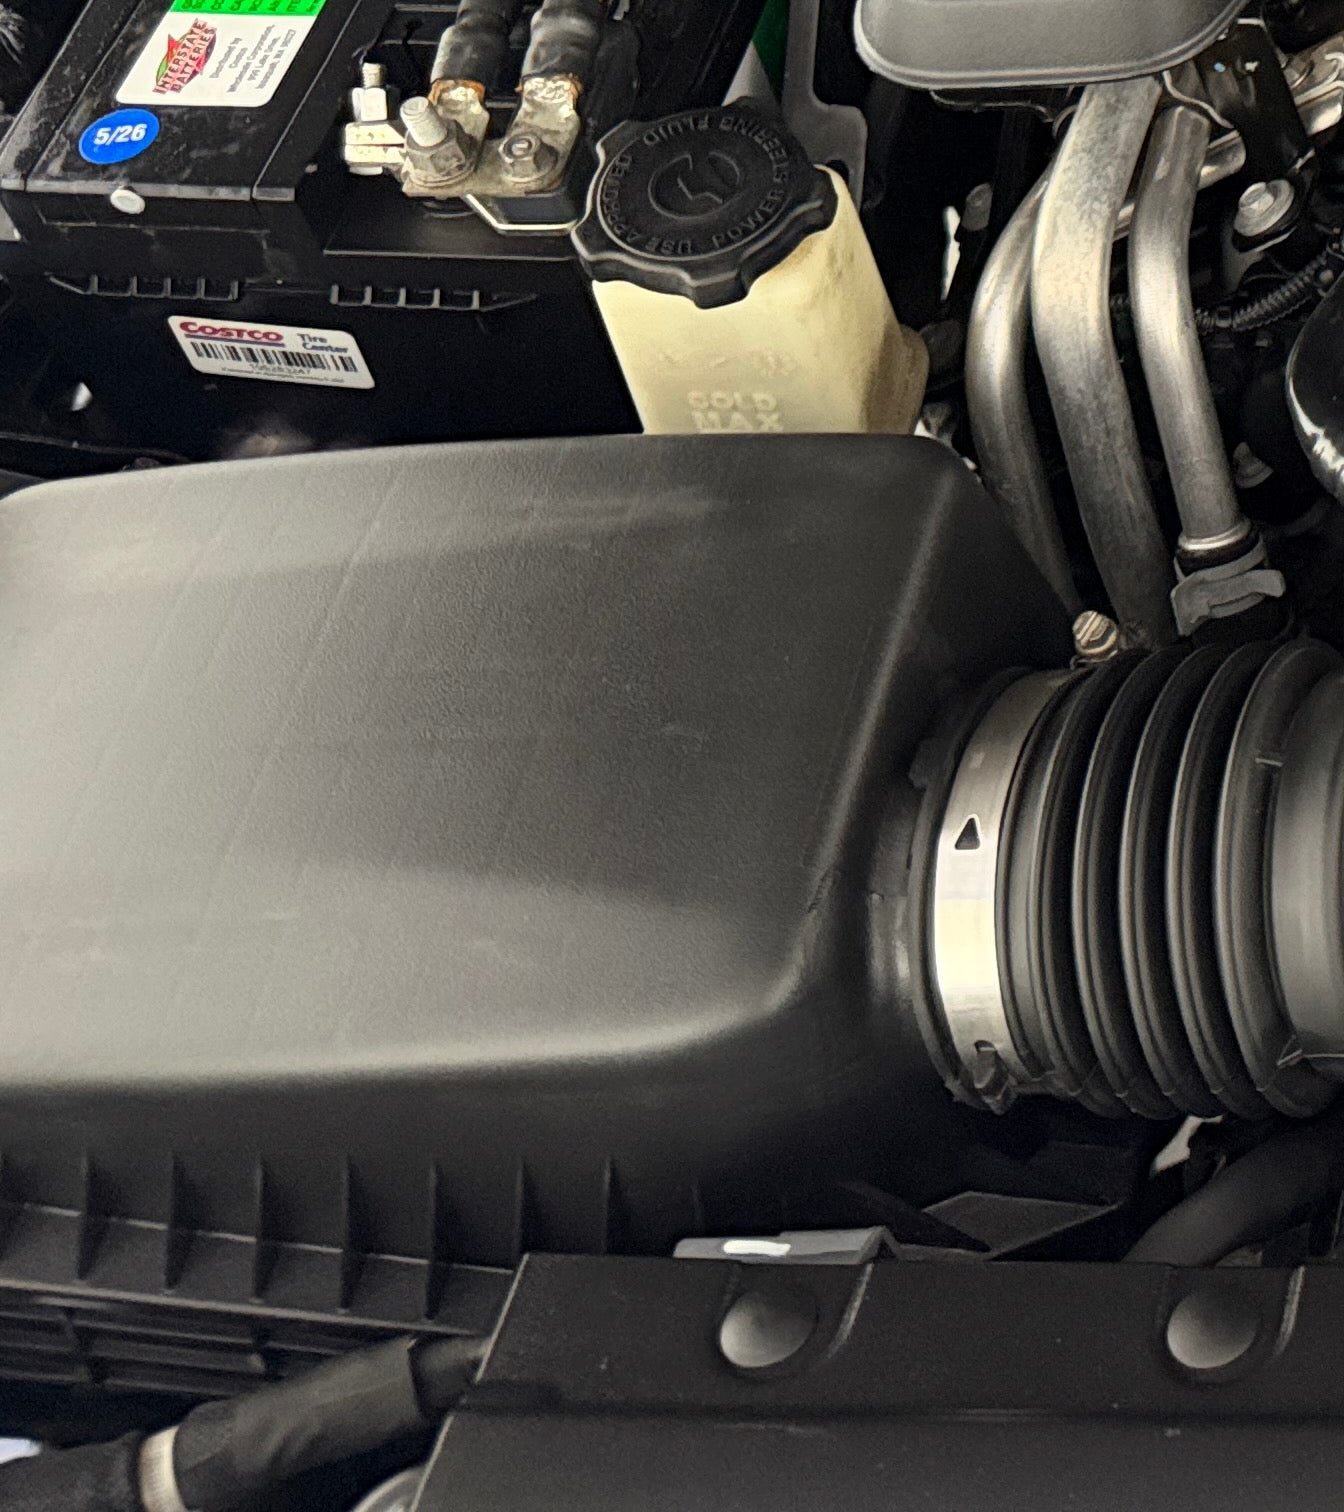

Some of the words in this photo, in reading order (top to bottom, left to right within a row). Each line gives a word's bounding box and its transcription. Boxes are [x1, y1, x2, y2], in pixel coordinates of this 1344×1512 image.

[93, 123, 148, 146] 5/26
[643, 114, 710, 147] FLUID
[719, 115, 790, 184] STEERING
[711, 187, 786, 248] POWER
[179, 321, 284, 343] COSTCO
[298, 332, 328, 345] Tire
[302, 342, 349, 355] Center
[688, 390, 777, 411] COLD
[691, 410, 784, 433] MAX
